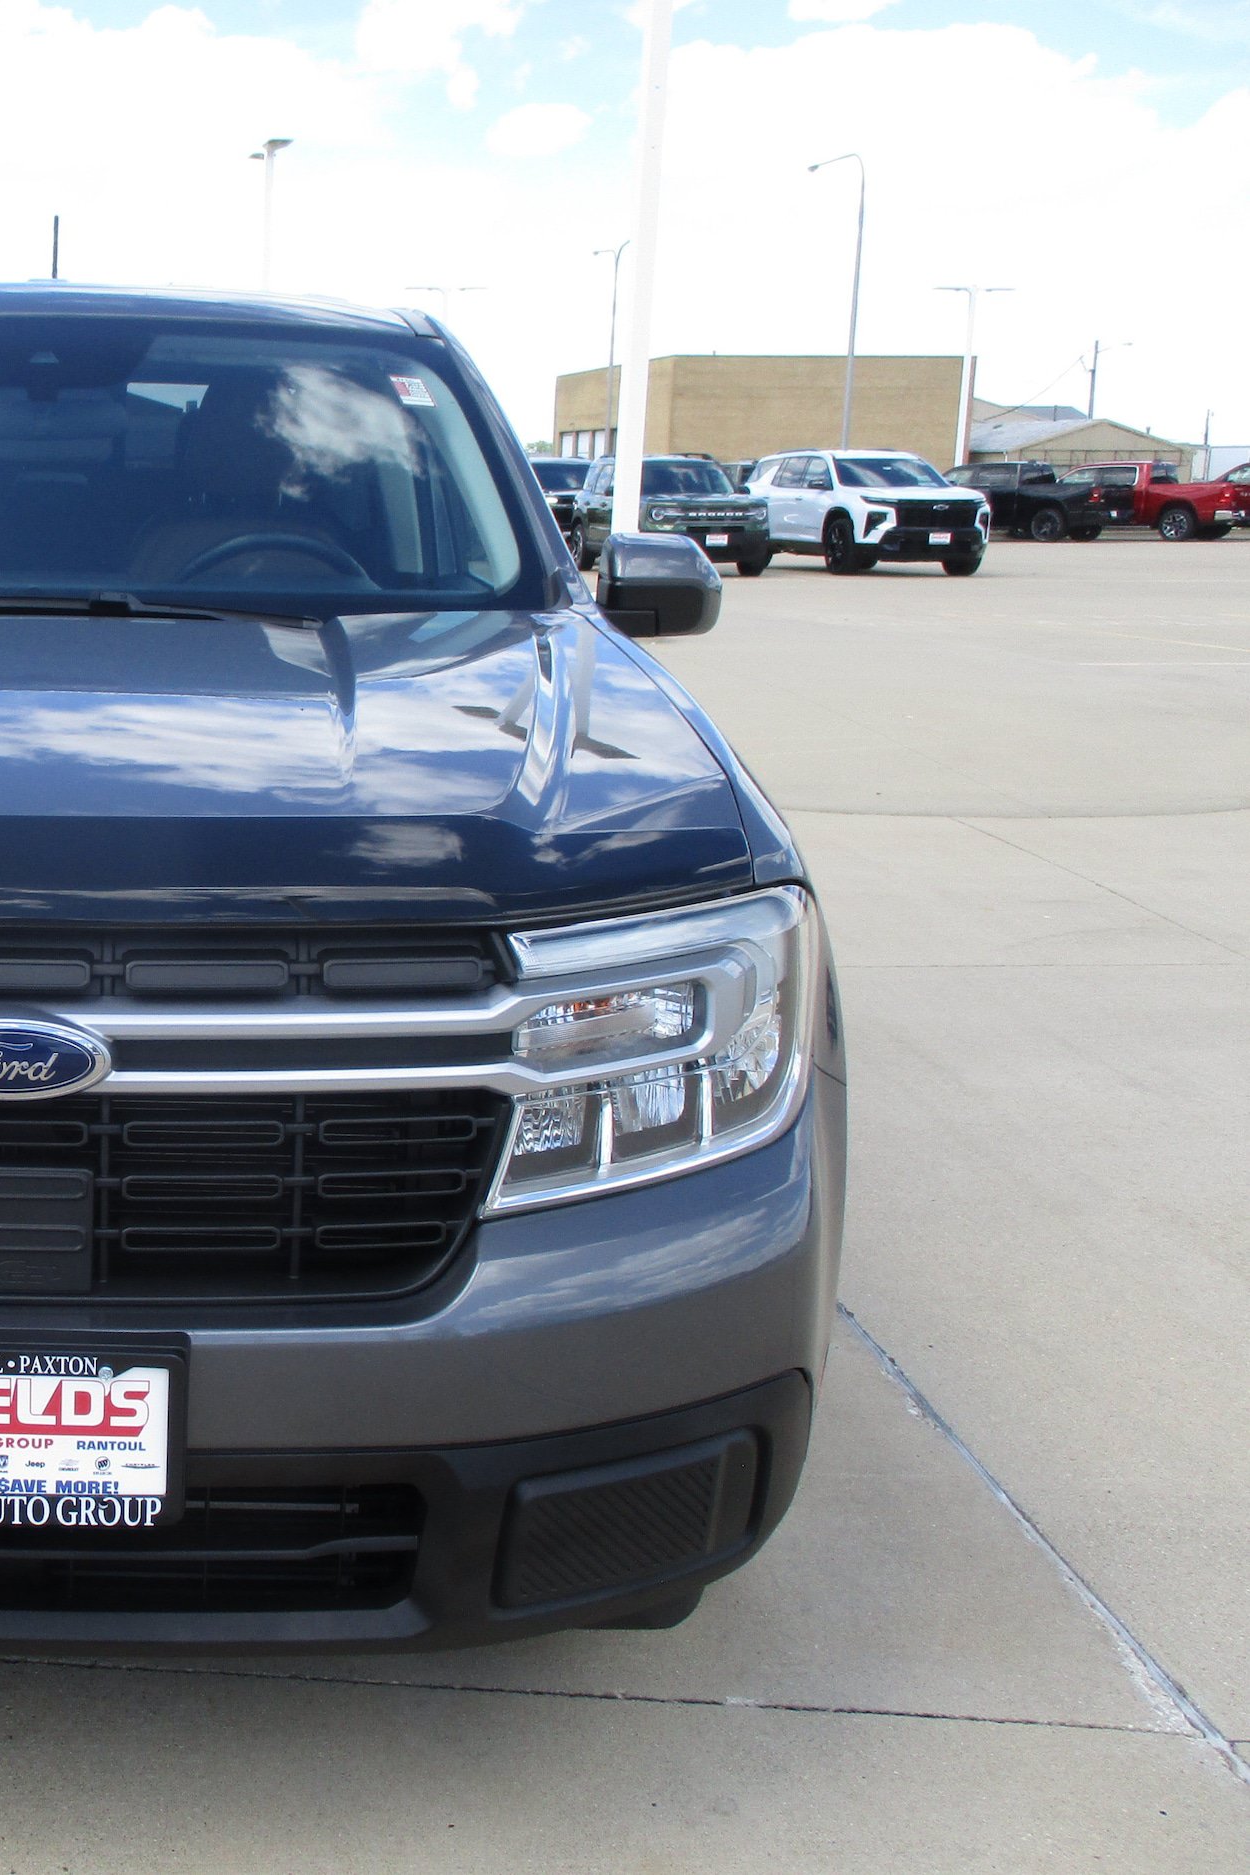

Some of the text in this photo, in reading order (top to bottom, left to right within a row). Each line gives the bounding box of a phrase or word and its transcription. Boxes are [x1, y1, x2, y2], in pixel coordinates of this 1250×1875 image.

[19, 1356, 98, 1376] PAXTON
[76, 1440, 146, 1451] RANTOUL
[25, 1460, 46, 1469] Jeep
[55, 1480, 119, 1494] MORE!
[56, 1494, 162, 1527] GROUP
